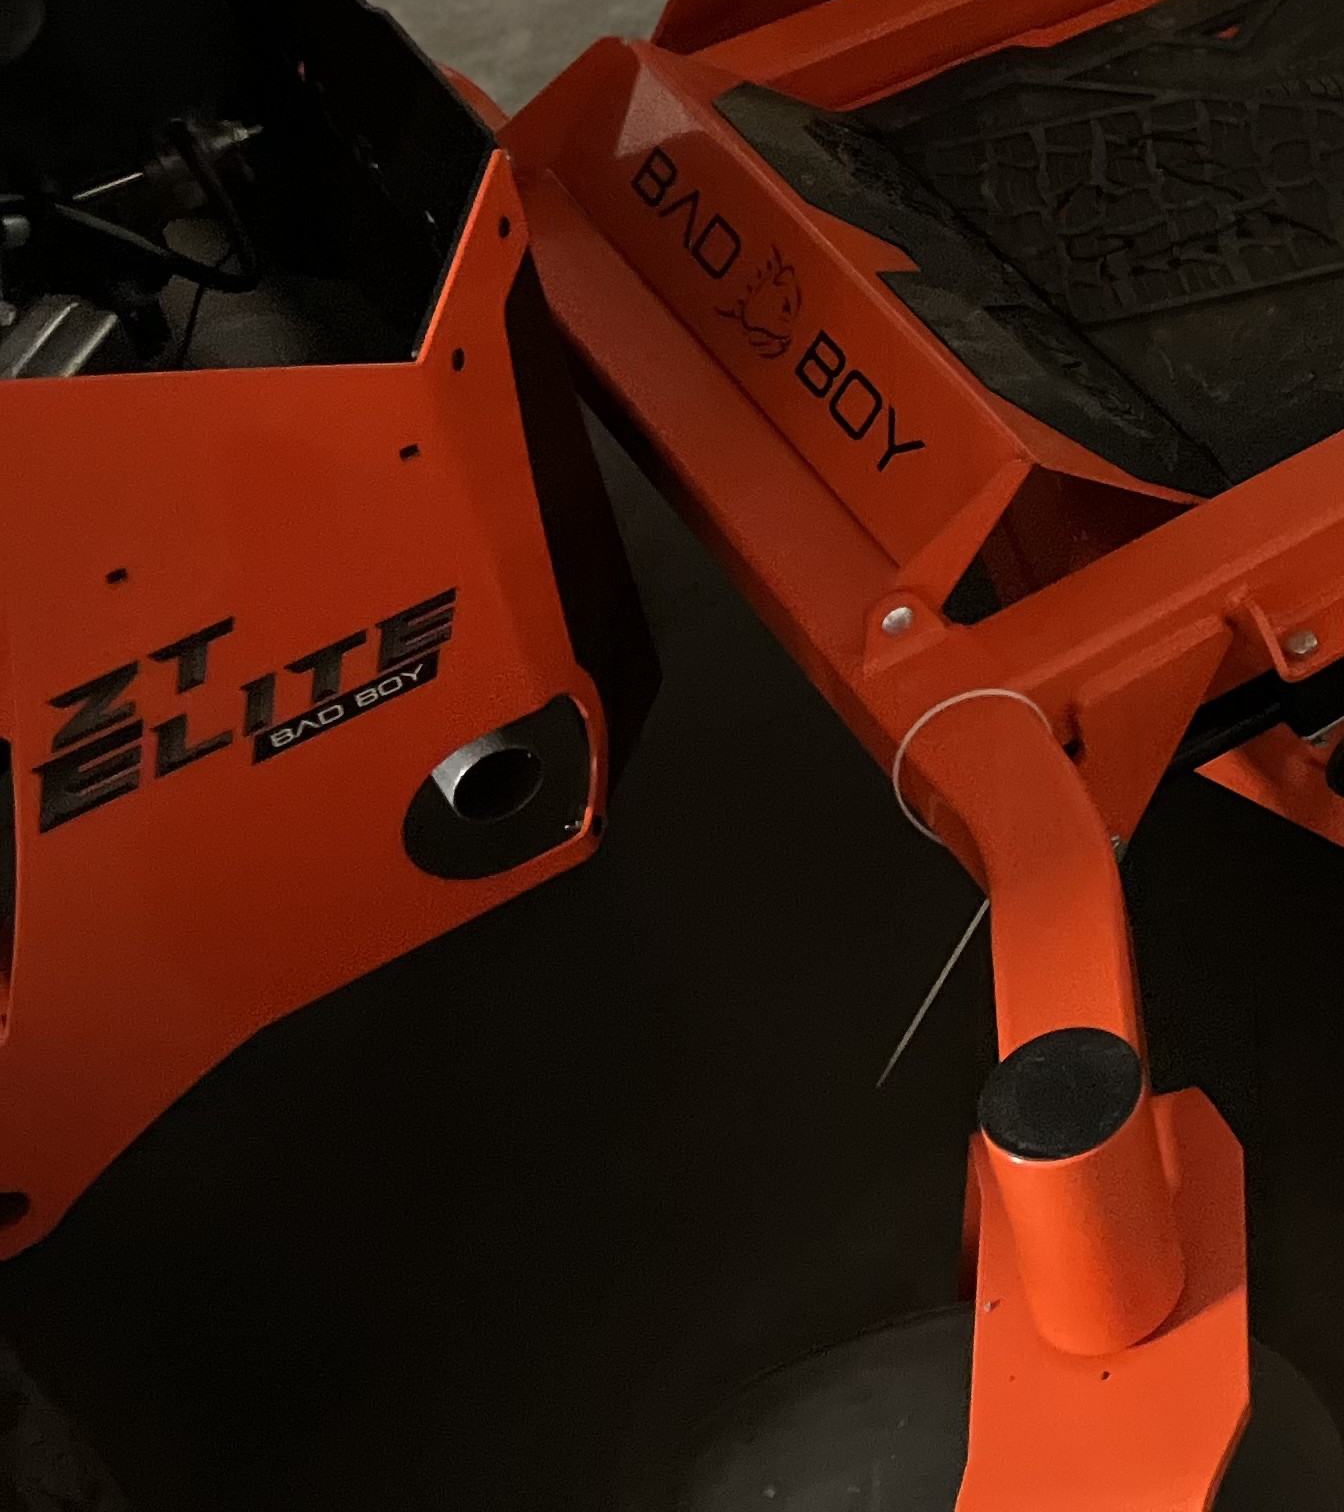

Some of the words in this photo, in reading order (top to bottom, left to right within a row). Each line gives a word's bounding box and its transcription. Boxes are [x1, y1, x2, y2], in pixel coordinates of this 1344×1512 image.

[630, 145, 742, 280] BAD
[795, 329, 926, 473] BOY
[32, 587, 457, 835] ELITE
[48, 616, 234, 753] ZT
[270, 704, 345, 748] BAD
[355, 663, 424, 707] BOY
